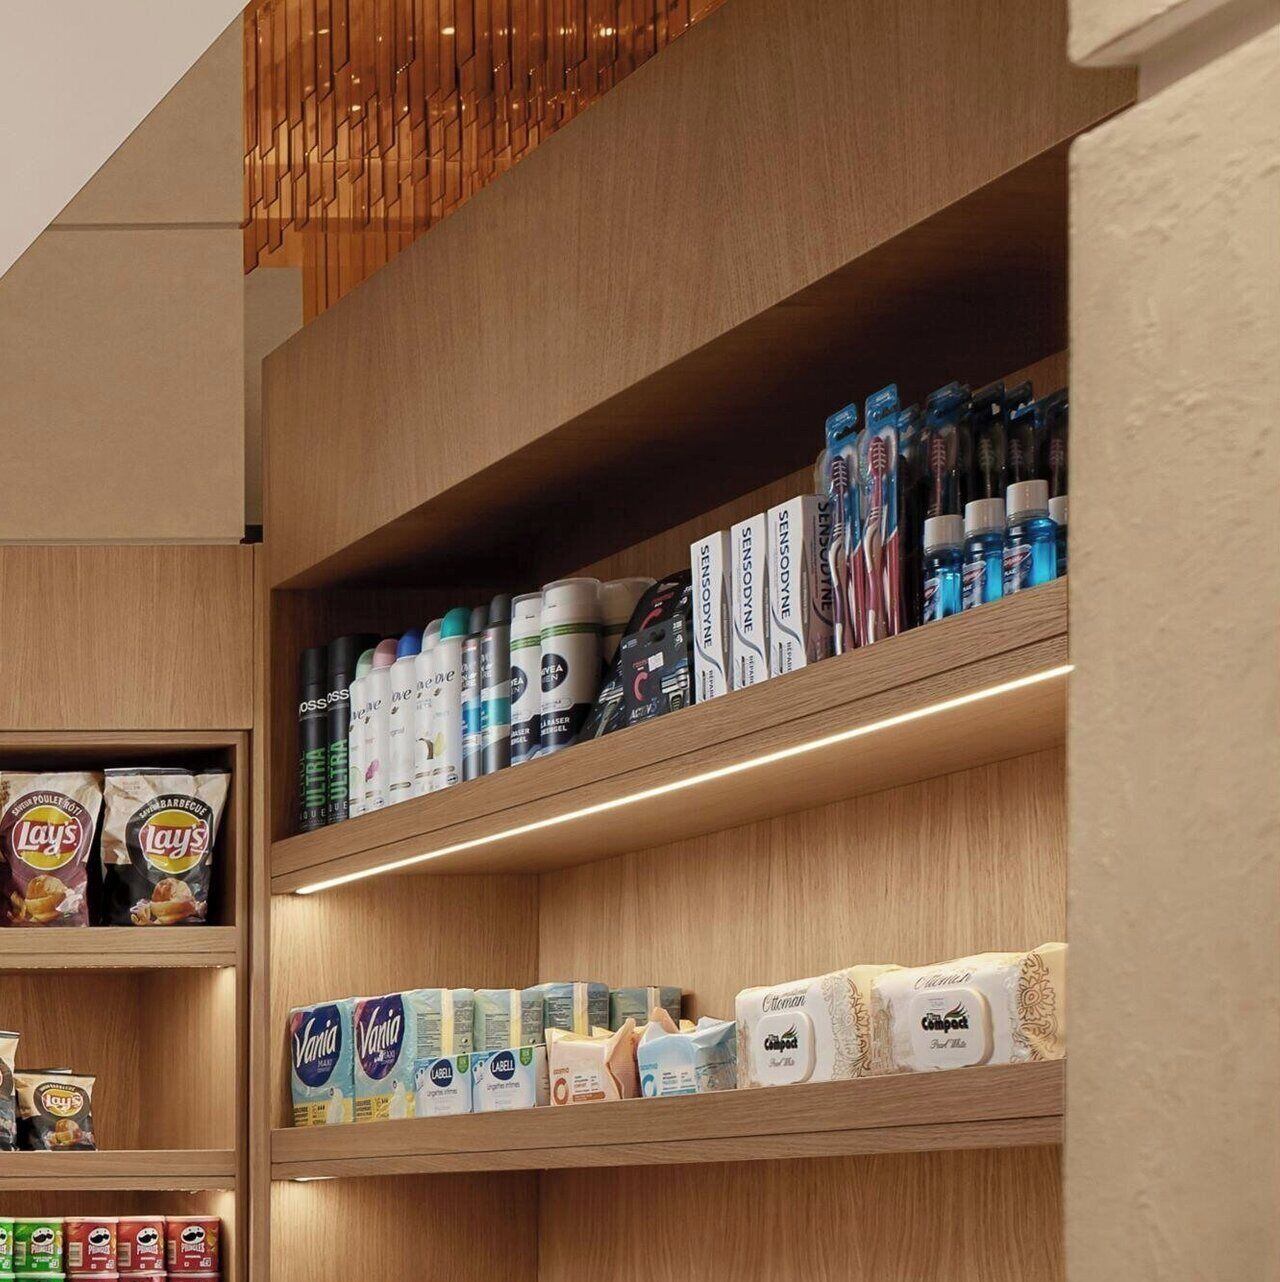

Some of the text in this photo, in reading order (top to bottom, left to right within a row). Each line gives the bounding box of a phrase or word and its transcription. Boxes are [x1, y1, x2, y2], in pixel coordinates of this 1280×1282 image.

[779, 509, 790, 619] SENSODYNE
[742, 526, 754, 633] SENSODYNE
[700, 545, 712, 648] SENSODYNE
[435, 670, 454, 682] ove
[392, 689, 412, 702] ove
[306, 748, 326, 808] ULTRA
[330, 740, 348, 800] ULTRA
[12, 798, 32, 816] SAVEUR
[32, 795, 62, 807] POULET
[160, 799, 207, 816] BARBECUE
[18, 822, 78, 856] Lay's
[146, 824, 206, 859] Lay's
[762, 993, 806, 1012] Ottoman
[360, 1008, 401, 1059] Vania
[922, 1016, 969, 1033] Compact
[294, 1018, 338, 1068] Vania
[764, 1036, 798, 1053] Compact
[432, 1068, 452, 1079] LABELL
[492, 1060, 514, 1072] LABELL
[46, 1093, 82, 1110] Lay's
